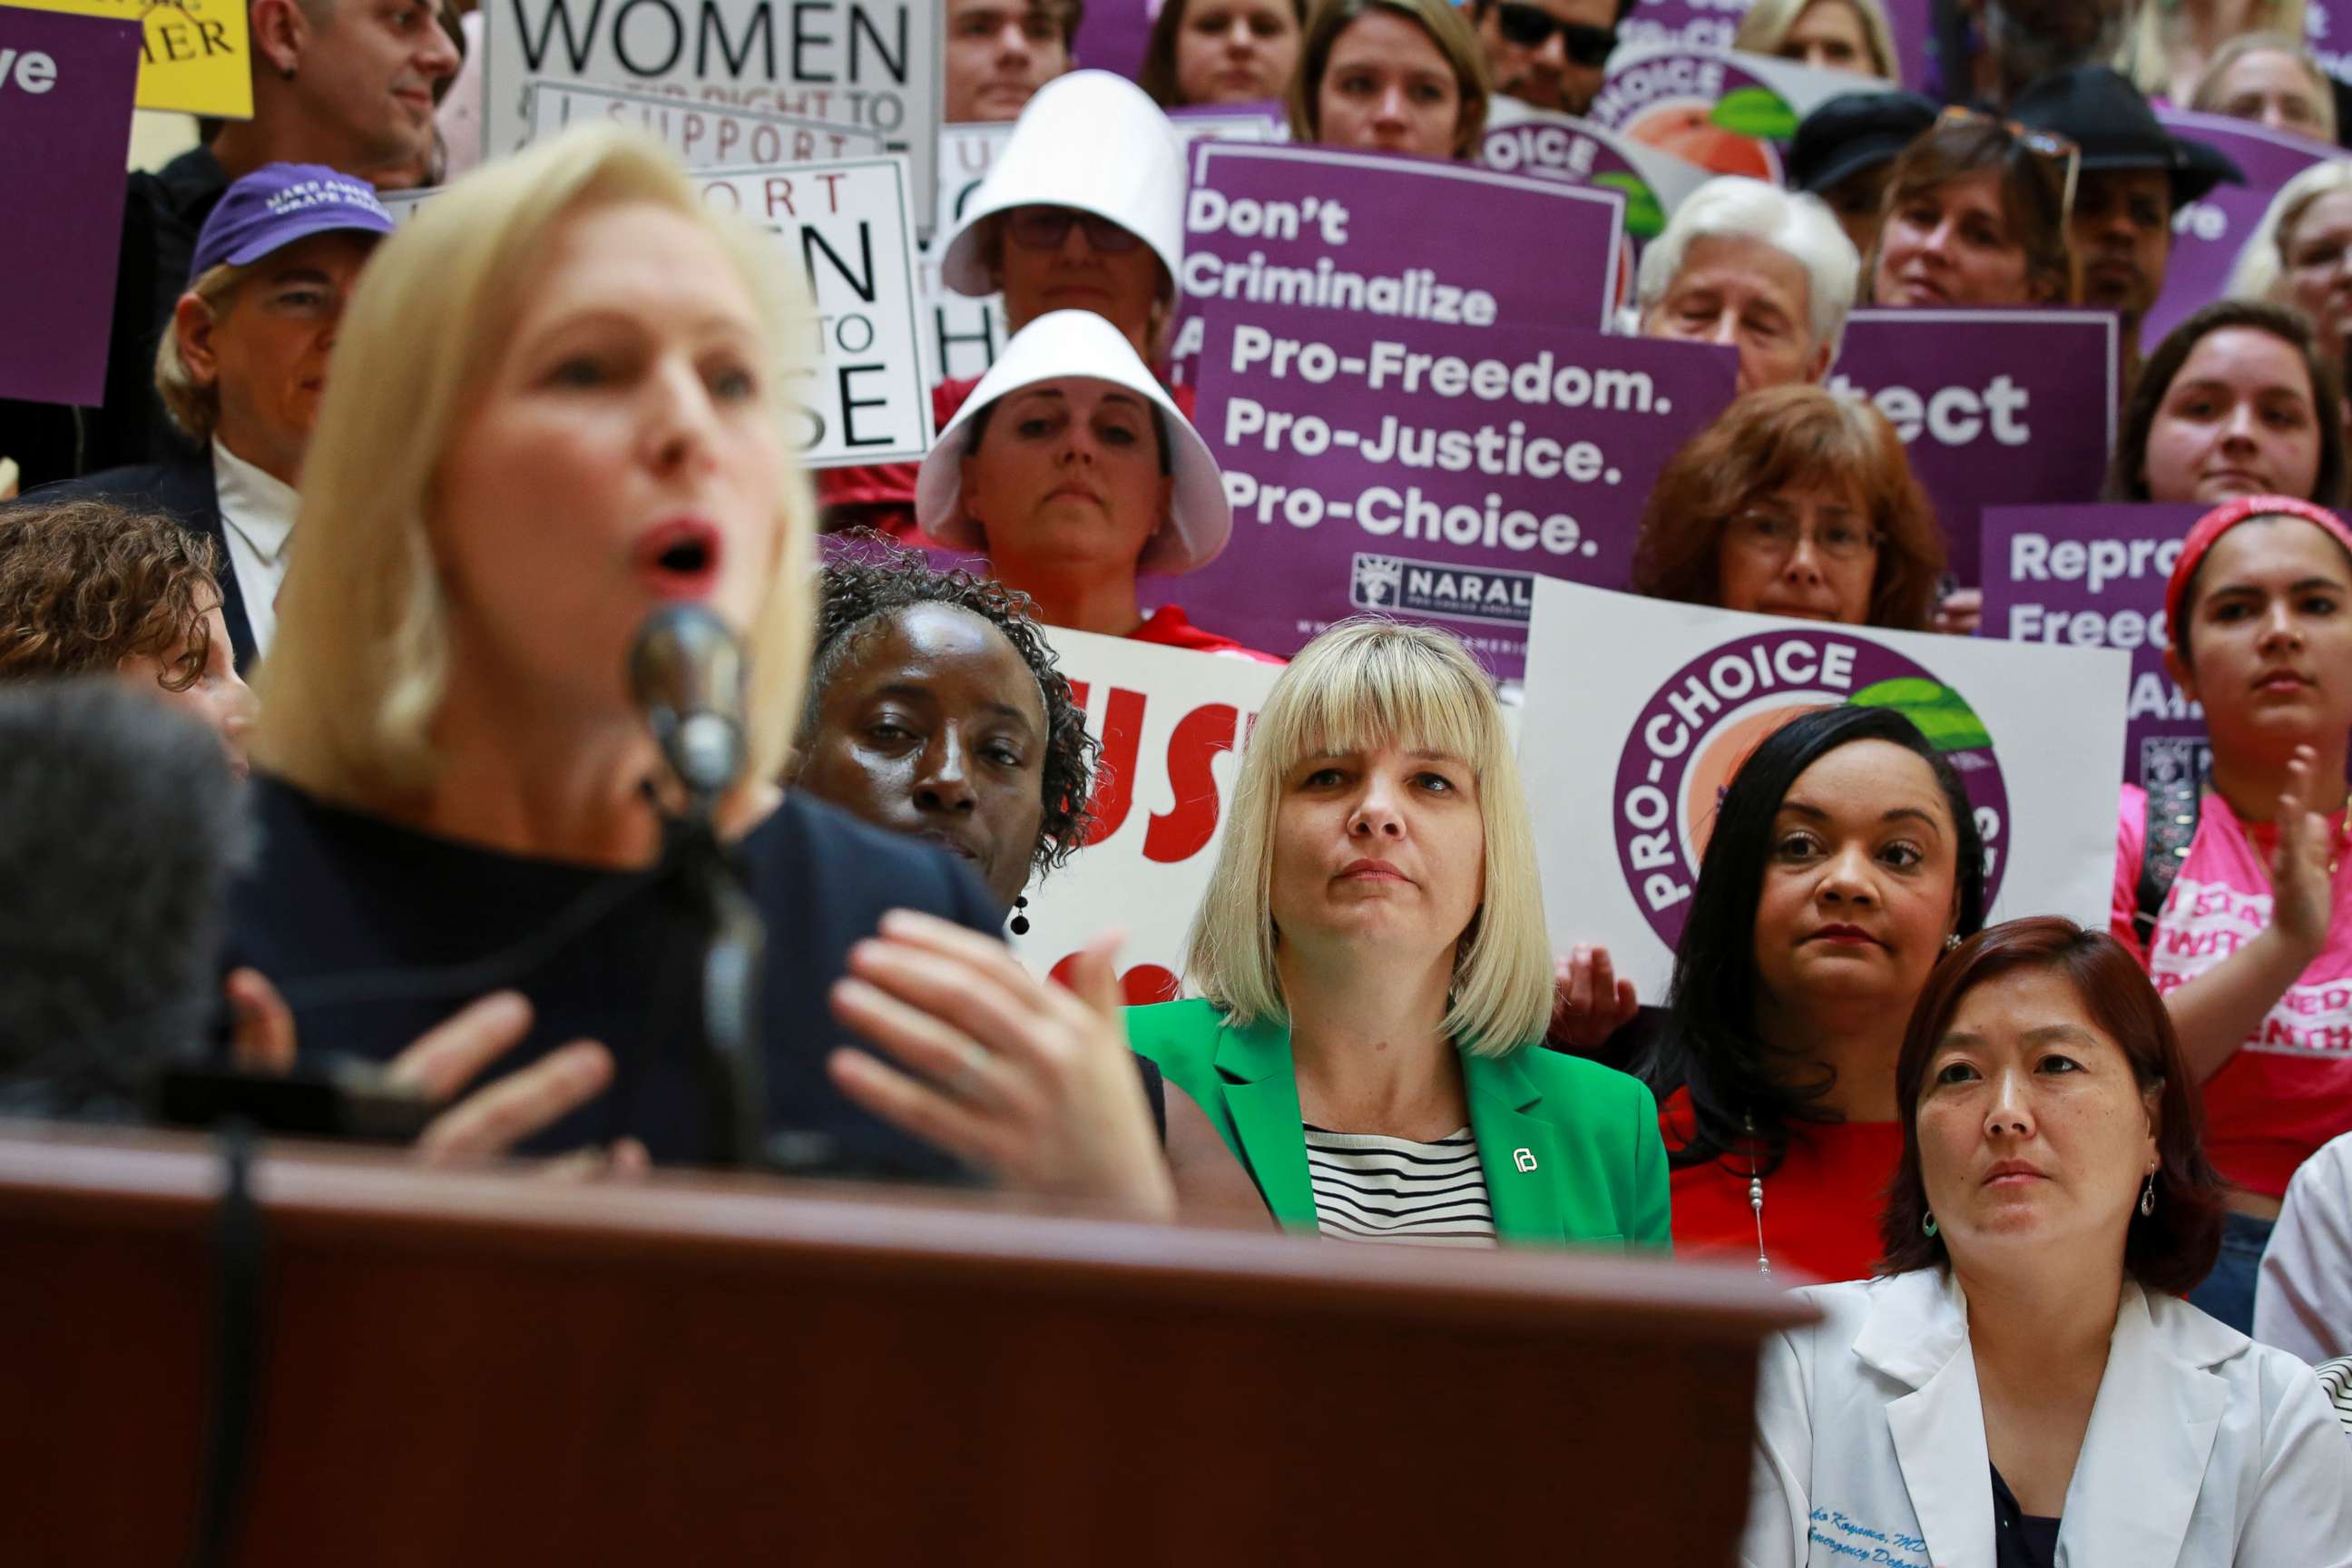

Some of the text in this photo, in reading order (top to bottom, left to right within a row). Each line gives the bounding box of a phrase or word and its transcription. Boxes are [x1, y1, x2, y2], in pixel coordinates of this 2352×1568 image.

[510, 0, 907, 85] WOMEN
[849, 93, 905, 132] TO
[1188, 189, 1349, 246] Don't
[1183, 251, 1497, 328] Criminalize
[1231, 324, 1672, 416] Pro-Freedom.
[1224, 397, 1622, 485] Pro-Justice.
[1221, 470, 1599, 558] Pro-Choice.
[1408, 568, 1530, 607] NARAL
[1048, 676, 1259, 865] US
[1624, 640, 1857, 911] PRO-CHOICE
